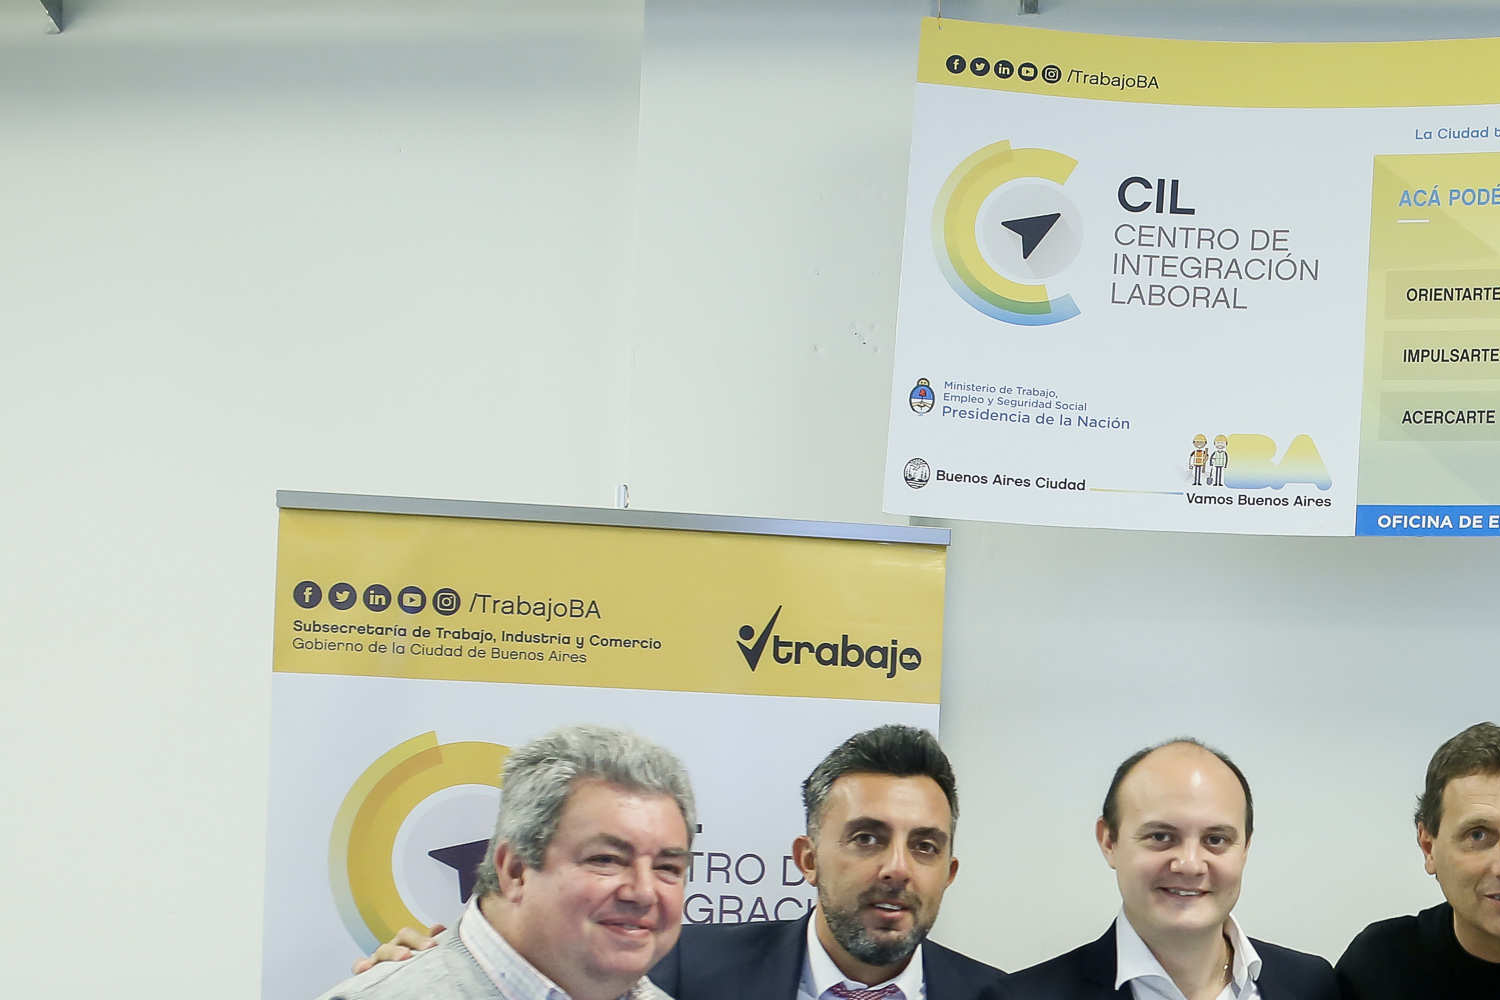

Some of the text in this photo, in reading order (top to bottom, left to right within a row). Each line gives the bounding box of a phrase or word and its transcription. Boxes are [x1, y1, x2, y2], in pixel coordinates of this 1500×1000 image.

[1067, 69, 1159, 91] /TrabajoBA
[1415, 128, 1432, 140] La
[1438, 126, 1489, 140] Ciudad
[1117, 176, 1196, 216] CIL
[1399, 185, 1441, 208] ACÁ
[1114, 224, 1290, 252] CENTRO DE
[1112, 253, 1320, 281] INTEGRACIÓN
[1111, 281, 1248, 309] LABORAL
[1403, 348, 1500, 363] IMPULSARTE
[943, 393, 1087, 411] Empleo y Seguridad Social
[944, 381, 1058, 399] Ministerio de Trabajo,
[942, 405, 1130, 430] Presidencia de la Nación
[1402, 410, 1496, 425] ACERCARTE
[1224, 433, 1332, 491] BA
[936, 469, 1086, 491] Buenos Aires Ciudad
[1186, 492, 1332, 507] Vamos Buenos Aires
[1377, 514, 1453, 529] OFICINA
[1459, 514, 1482, 529] DE
[469, 592, 602, 622] /TrabajoBA
[293, 619, 662, 650] Subsecretaría de Trabajo, Industria y Comercio
[292, 637, 587, 663] Gobierno de la Ciudad de Buenos Aires
[773, 634, 922, 679] trabajo
[689, 851, 808, 886] TRO D
